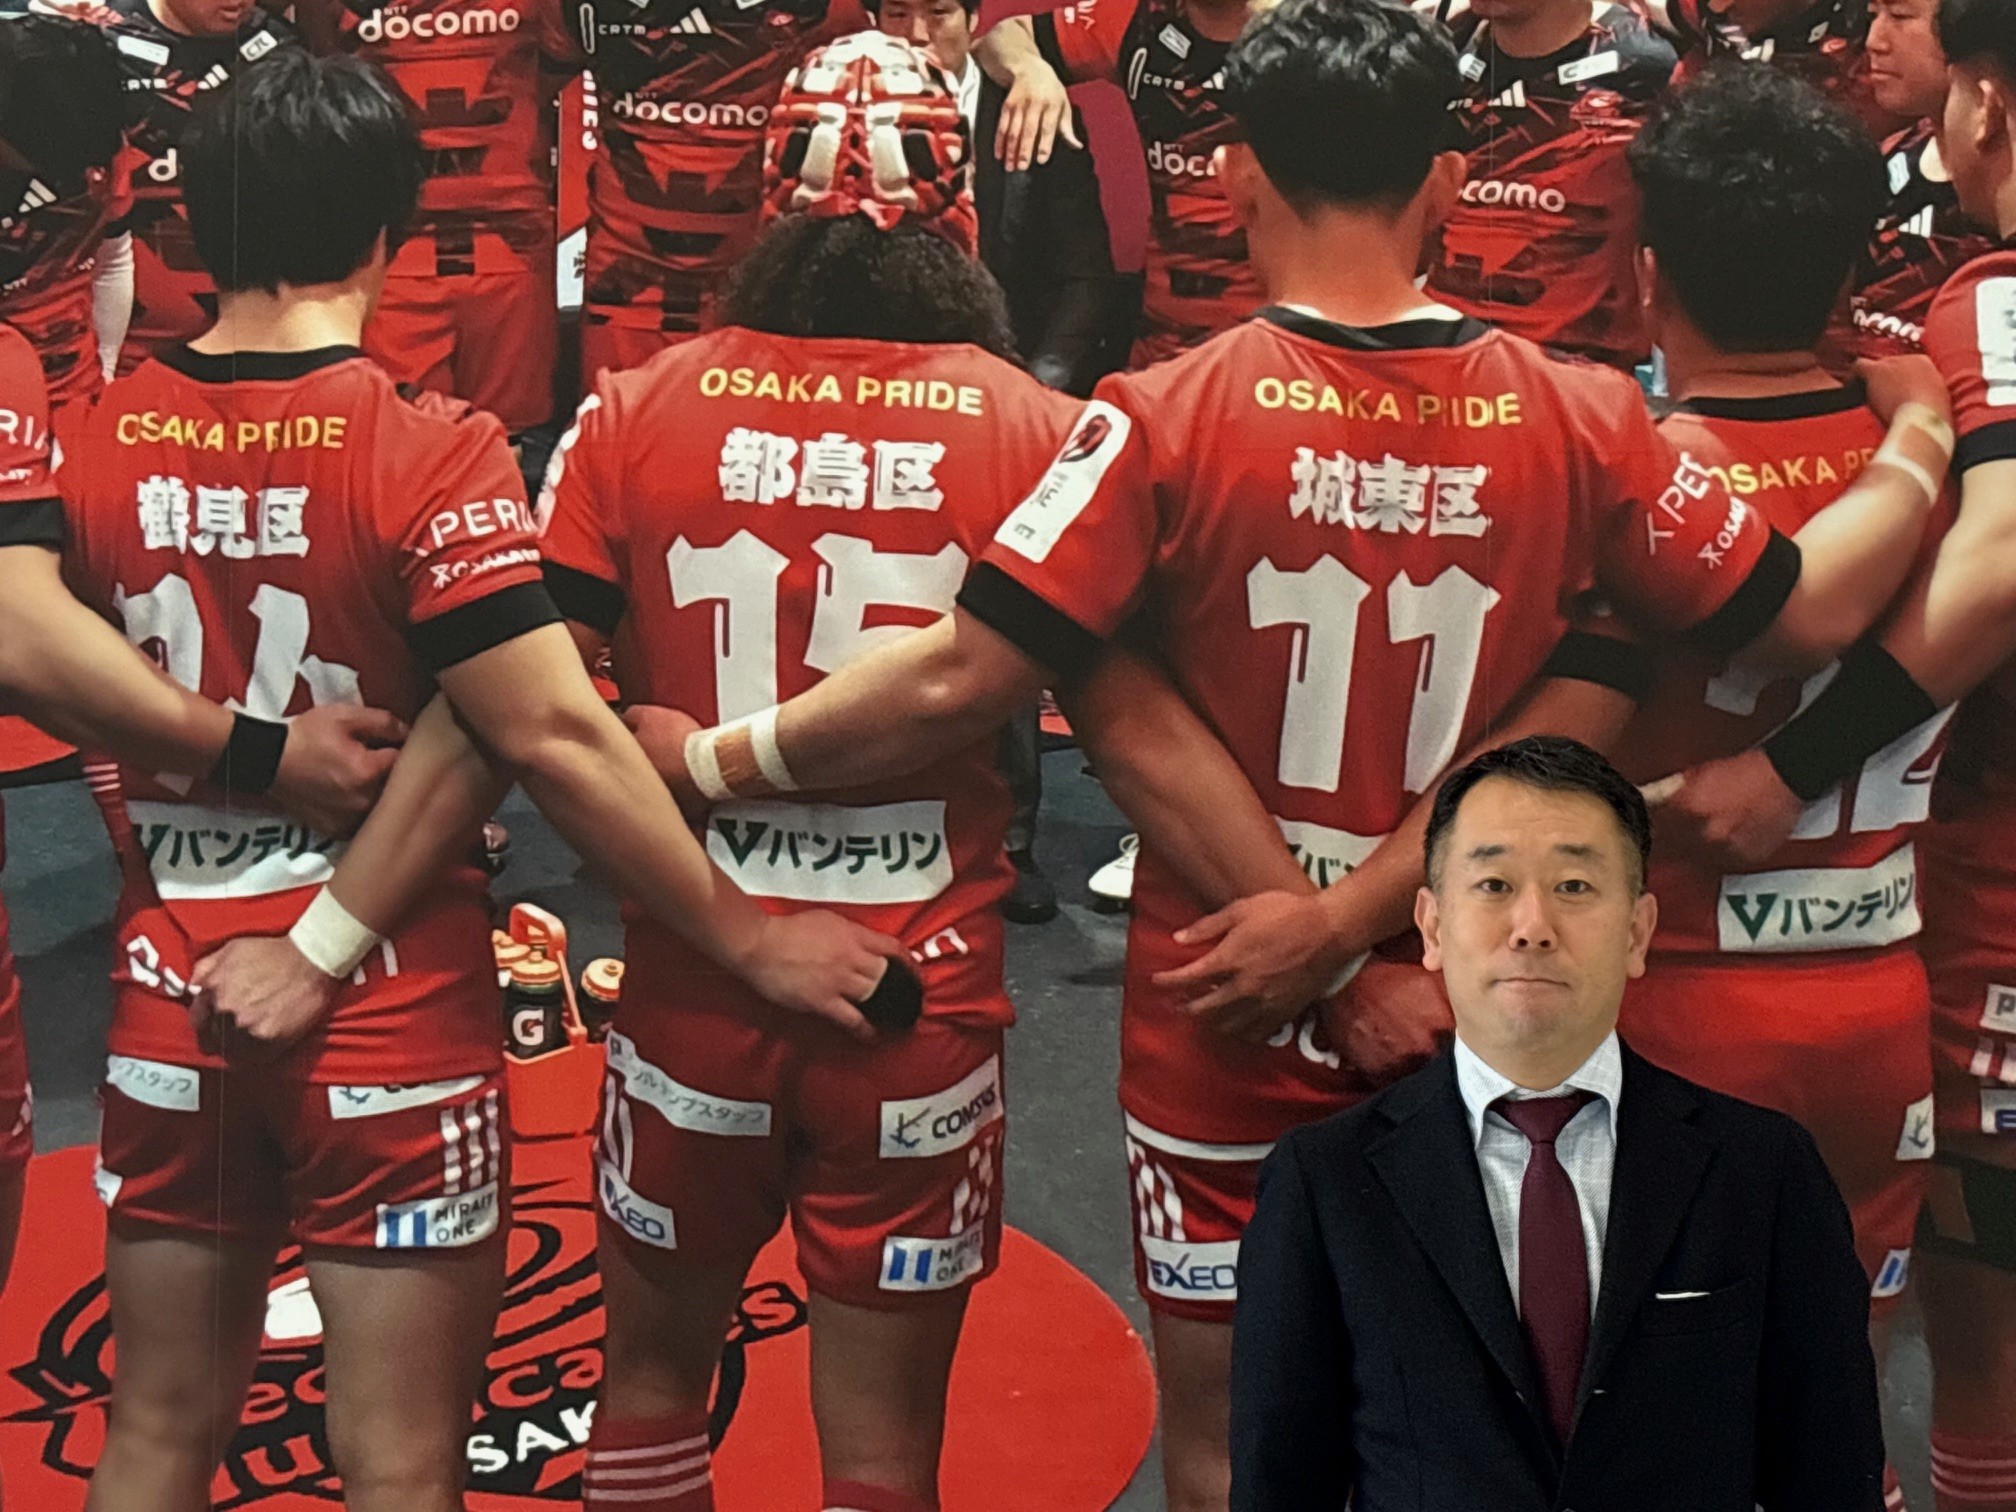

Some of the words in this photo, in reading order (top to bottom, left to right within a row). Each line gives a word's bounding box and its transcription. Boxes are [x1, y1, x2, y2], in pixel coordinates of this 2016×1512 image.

[358, 9, 520, 42] docomo
[613, 91, 769, 127] docomo
[1458, 179, 1566, 213] como
[700, 367, 842, 403] OSAKA
[856, 375, 984, 417] PRIDE
[1254, 377, 1402, 423] OSAKA
[1416, 392, 1522, 428] PIDE
[116, 411, 224, 452] OSAKA
[718, 426, 946, 511] 都島区
[1288, 446, 1493, 537] 城東区
[1246, 553, 1502, 795] 11
[168, 825, 335, 868] バンテリ
[768, 829, 941, 873] バンテリン
[1779, 873, 1915, 936] バンテリン
[436, 1219, 476, 1243] ONE
